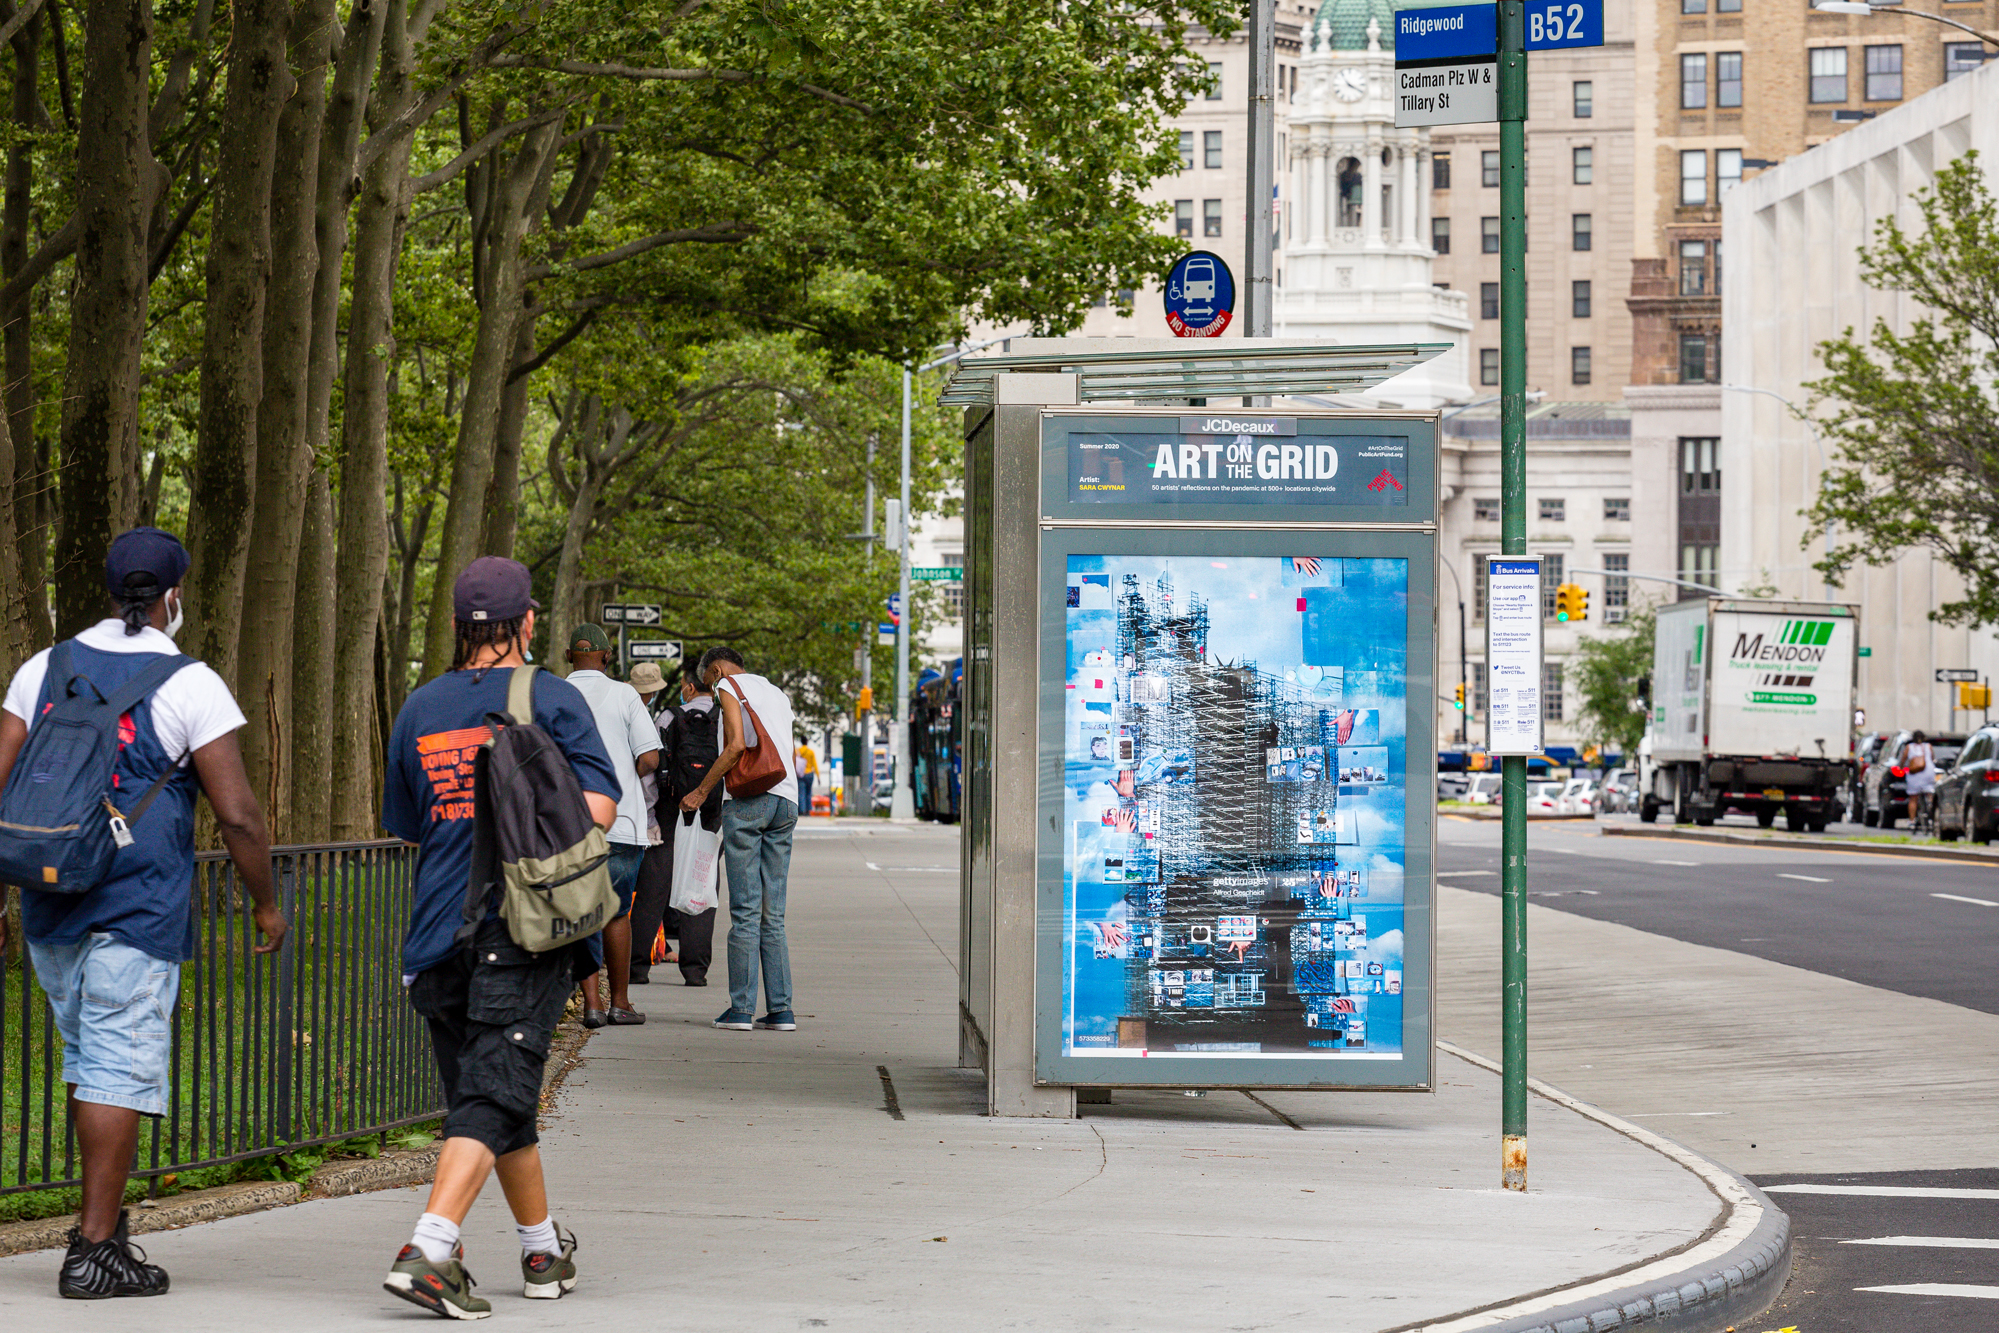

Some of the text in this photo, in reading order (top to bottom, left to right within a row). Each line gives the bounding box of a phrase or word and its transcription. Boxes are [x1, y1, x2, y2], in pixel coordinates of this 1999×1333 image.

[1401, 13, 1464, 36] Ridgewood
[1530, 4, 1584, 42] B52
[1401, 68, 1491, 89] Cadman Plz W &
[1401, 93, 1450, 113] Tillary St
[1170, 315, 1226, 337] NO STANDING
[1202, 419, 1275, 433] JCDecaux
[1153, 444, 1339, 479] ART ON THE GRID
[1312, 485, 1336, 493] citywide
[1367, 469, 1390, 491] PUBLIC
[1376, 478, 1390, 493] ART
[1387, 473, 1404, 492] FUND
[912, 568, 952, 579] Johnson
